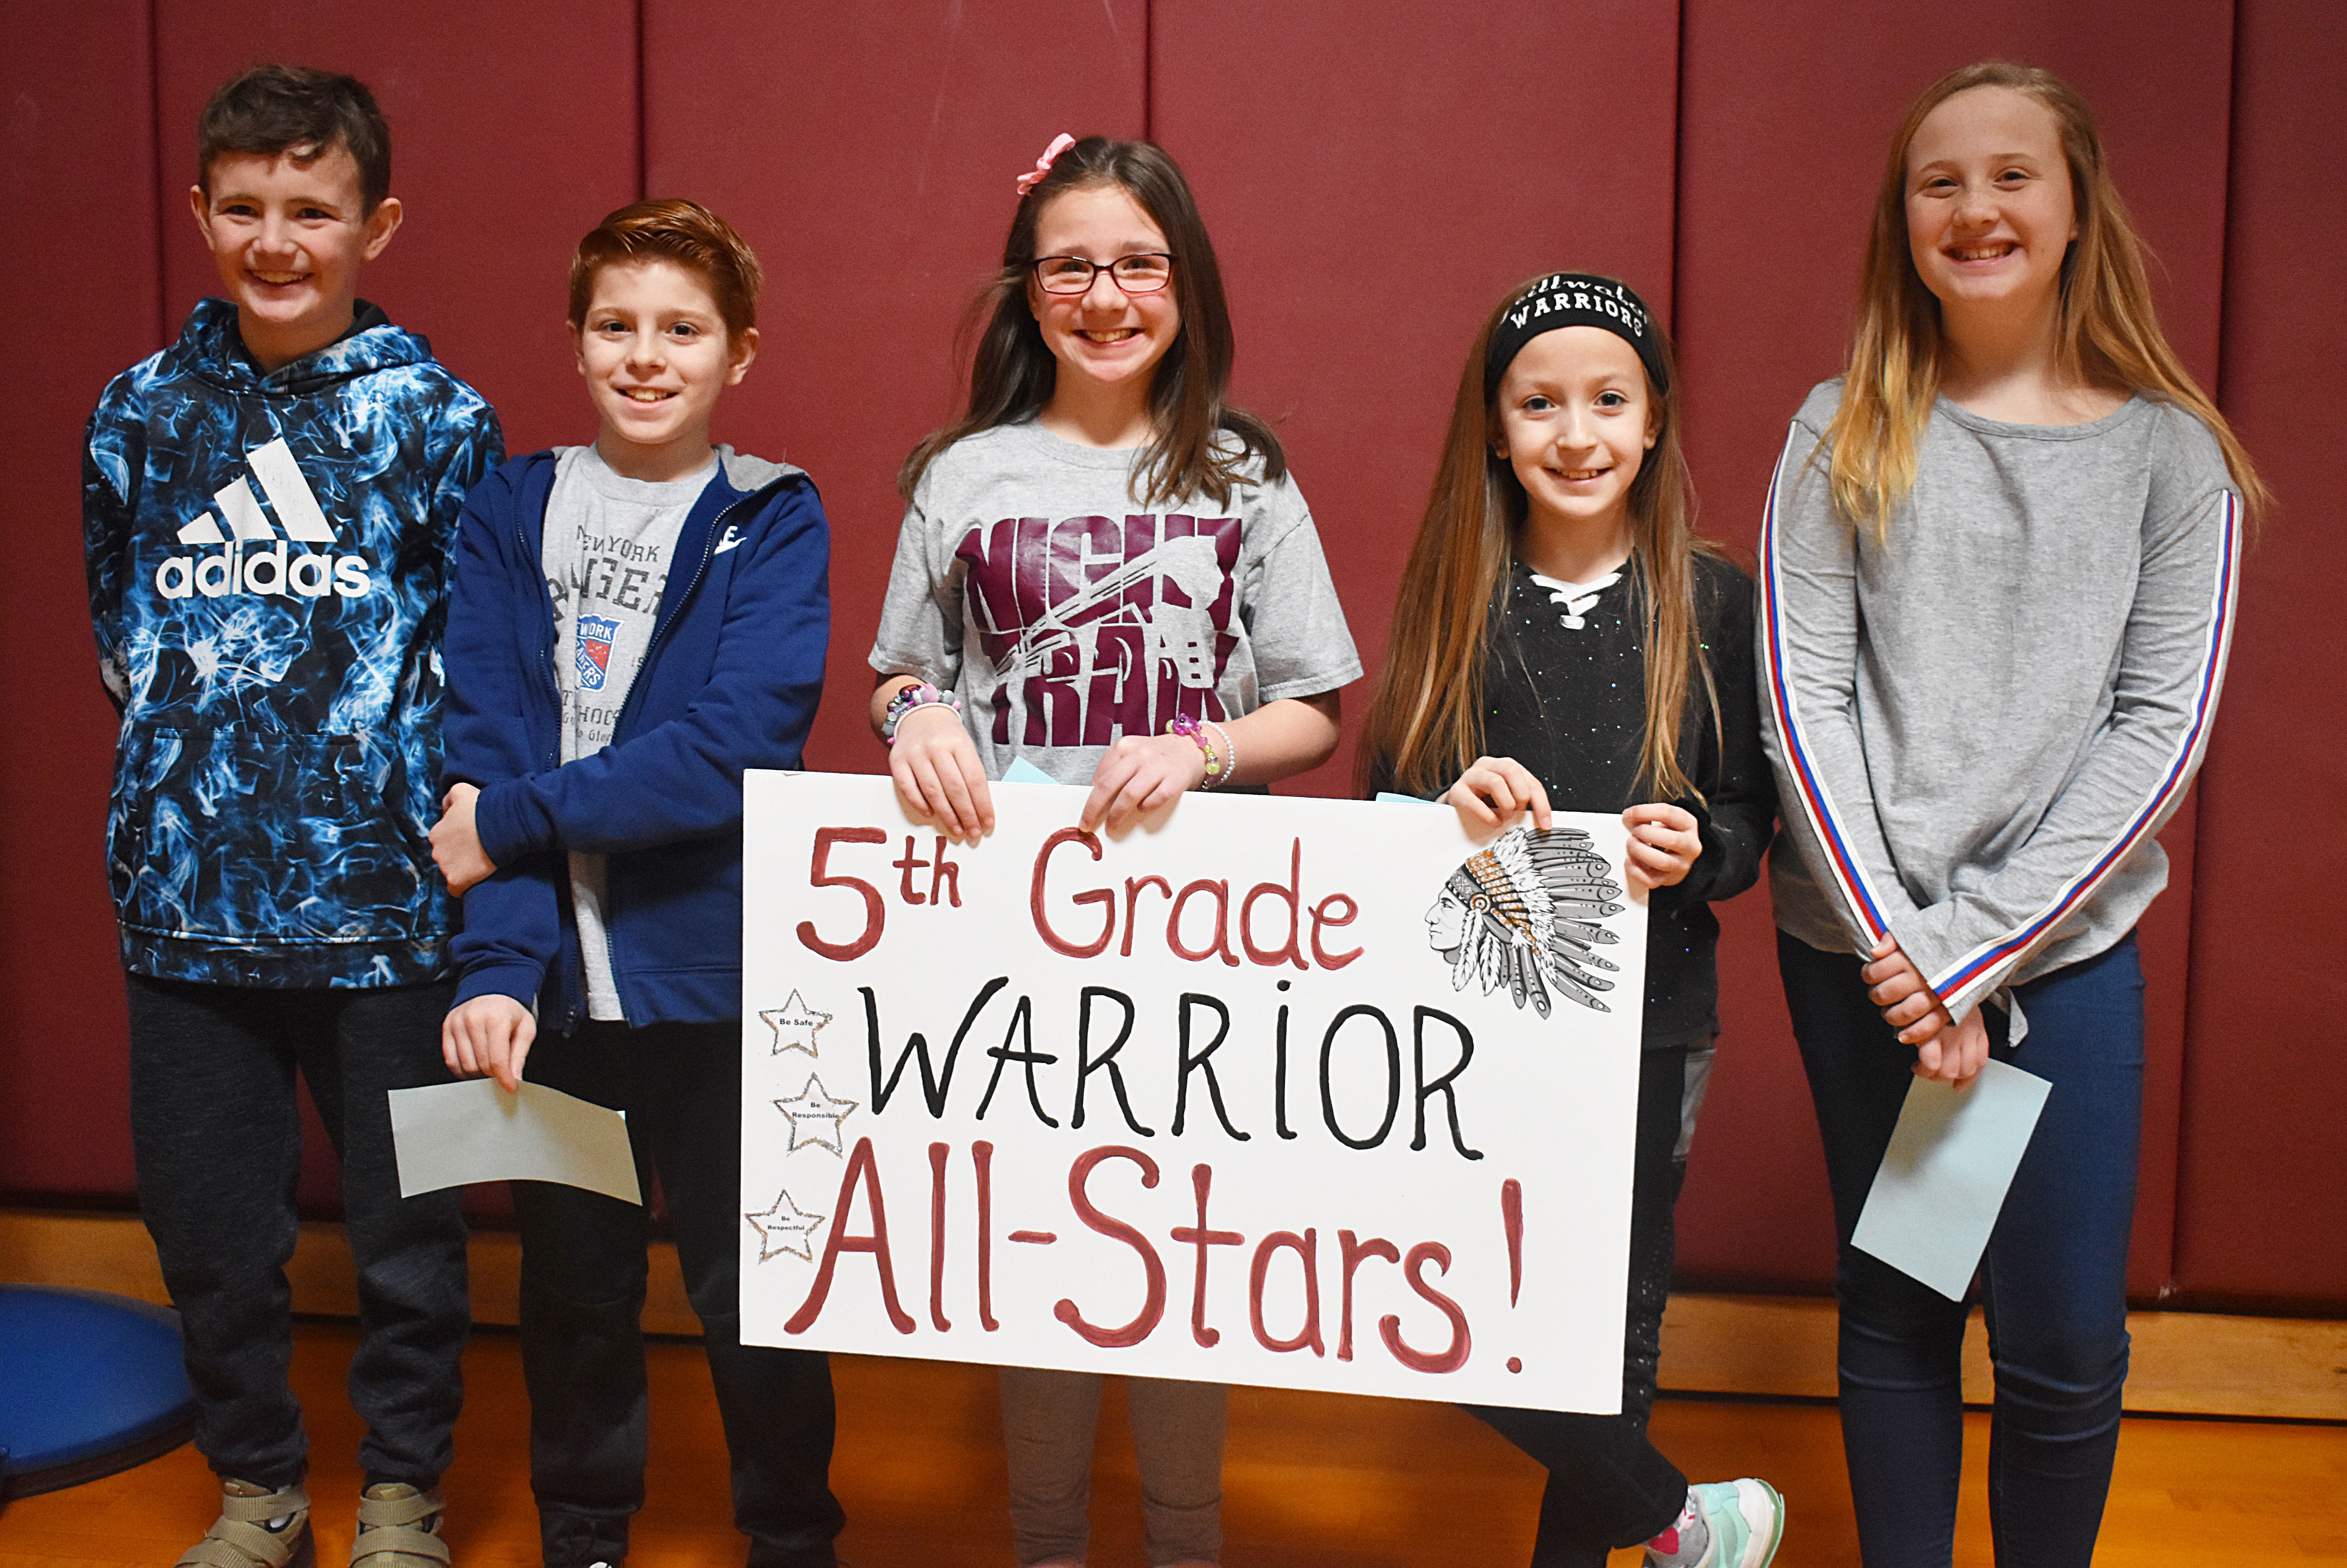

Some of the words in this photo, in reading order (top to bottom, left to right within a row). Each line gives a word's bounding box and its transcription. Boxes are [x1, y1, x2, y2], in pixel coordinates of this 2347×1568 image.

[1510, 292, 1642, 337] WARRIORS
[156, 540, 371, 599] adidas
[608, 535, 661, 562] YORK
[955, 514, 1242, 633] NIGHT
[796, 826, 963, 962] 5th
[1030, 826, 1365, 971] Grade
